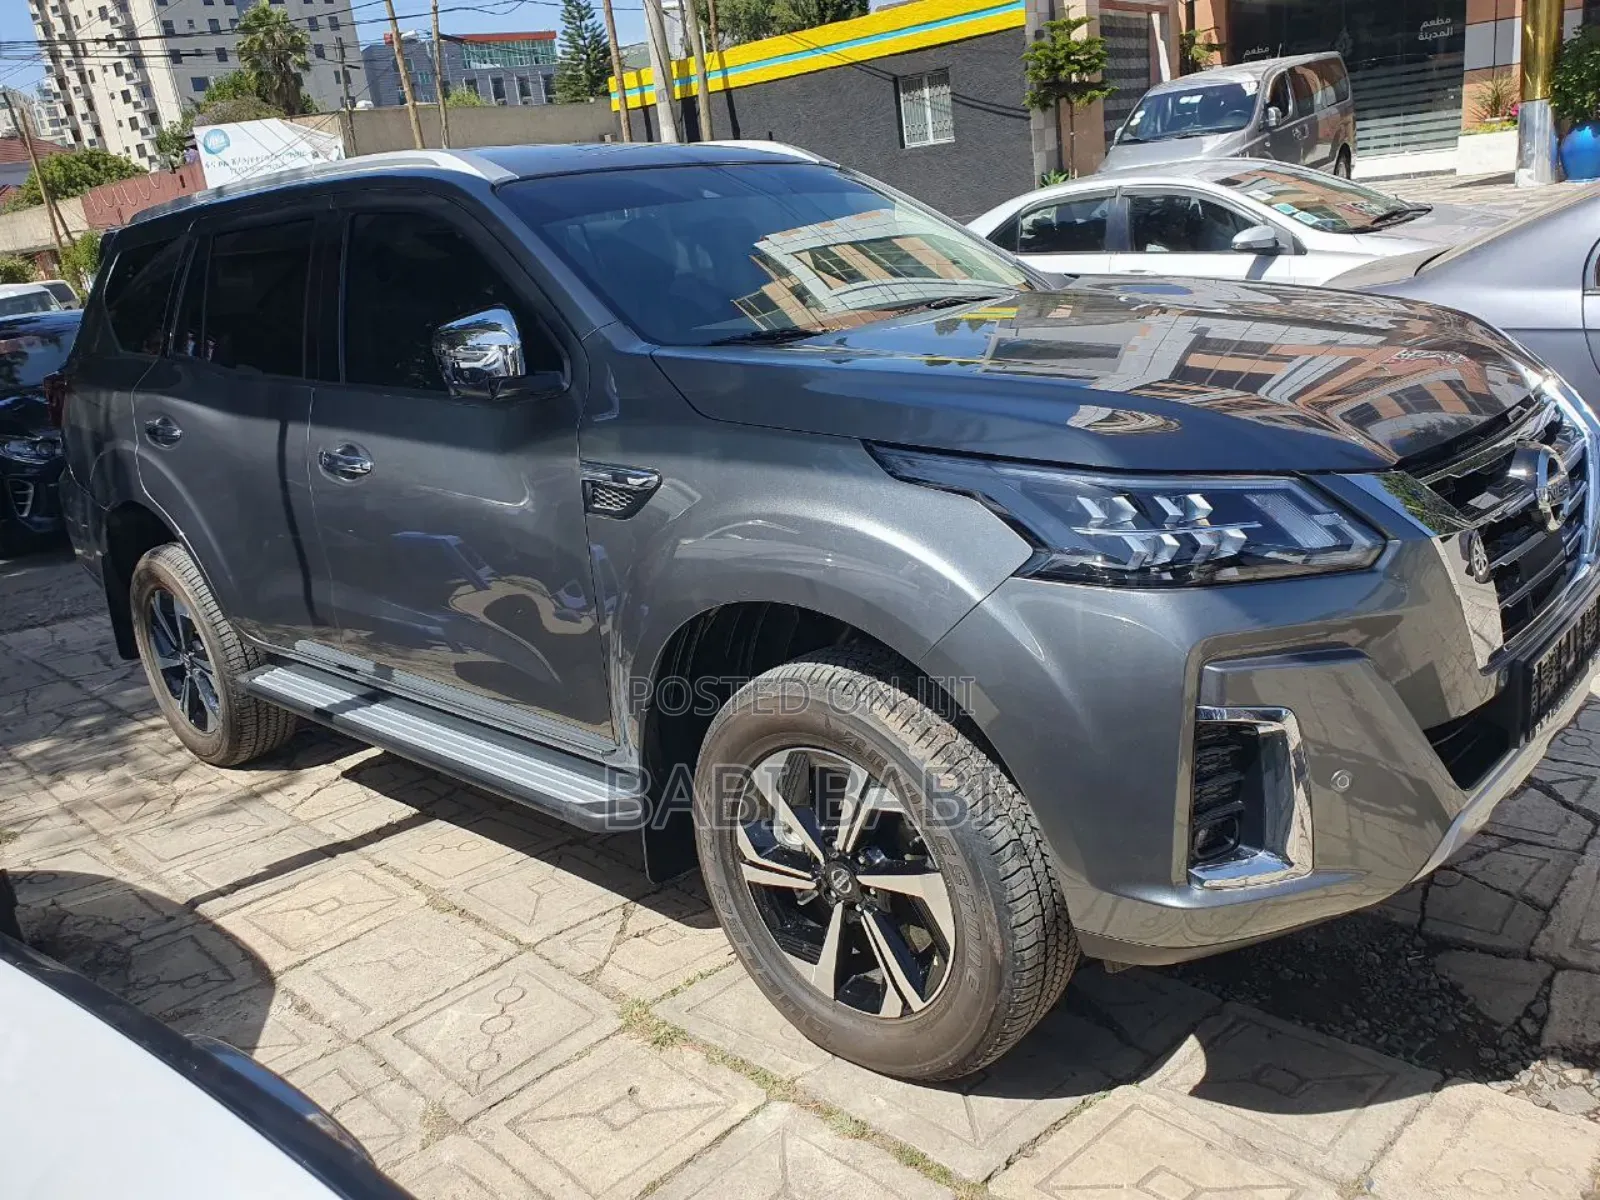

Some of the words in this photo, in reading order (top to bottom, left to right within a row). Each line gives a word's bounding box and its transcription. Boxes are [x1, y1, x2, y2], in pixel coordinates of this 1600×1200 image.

[1420, 16, 1452, 32] مطعم
[1418, 26, 1454, 41] المدينة
[1243, 45, 1270, 58] مطعم
[711, 882, 832, 1043] DUELER
